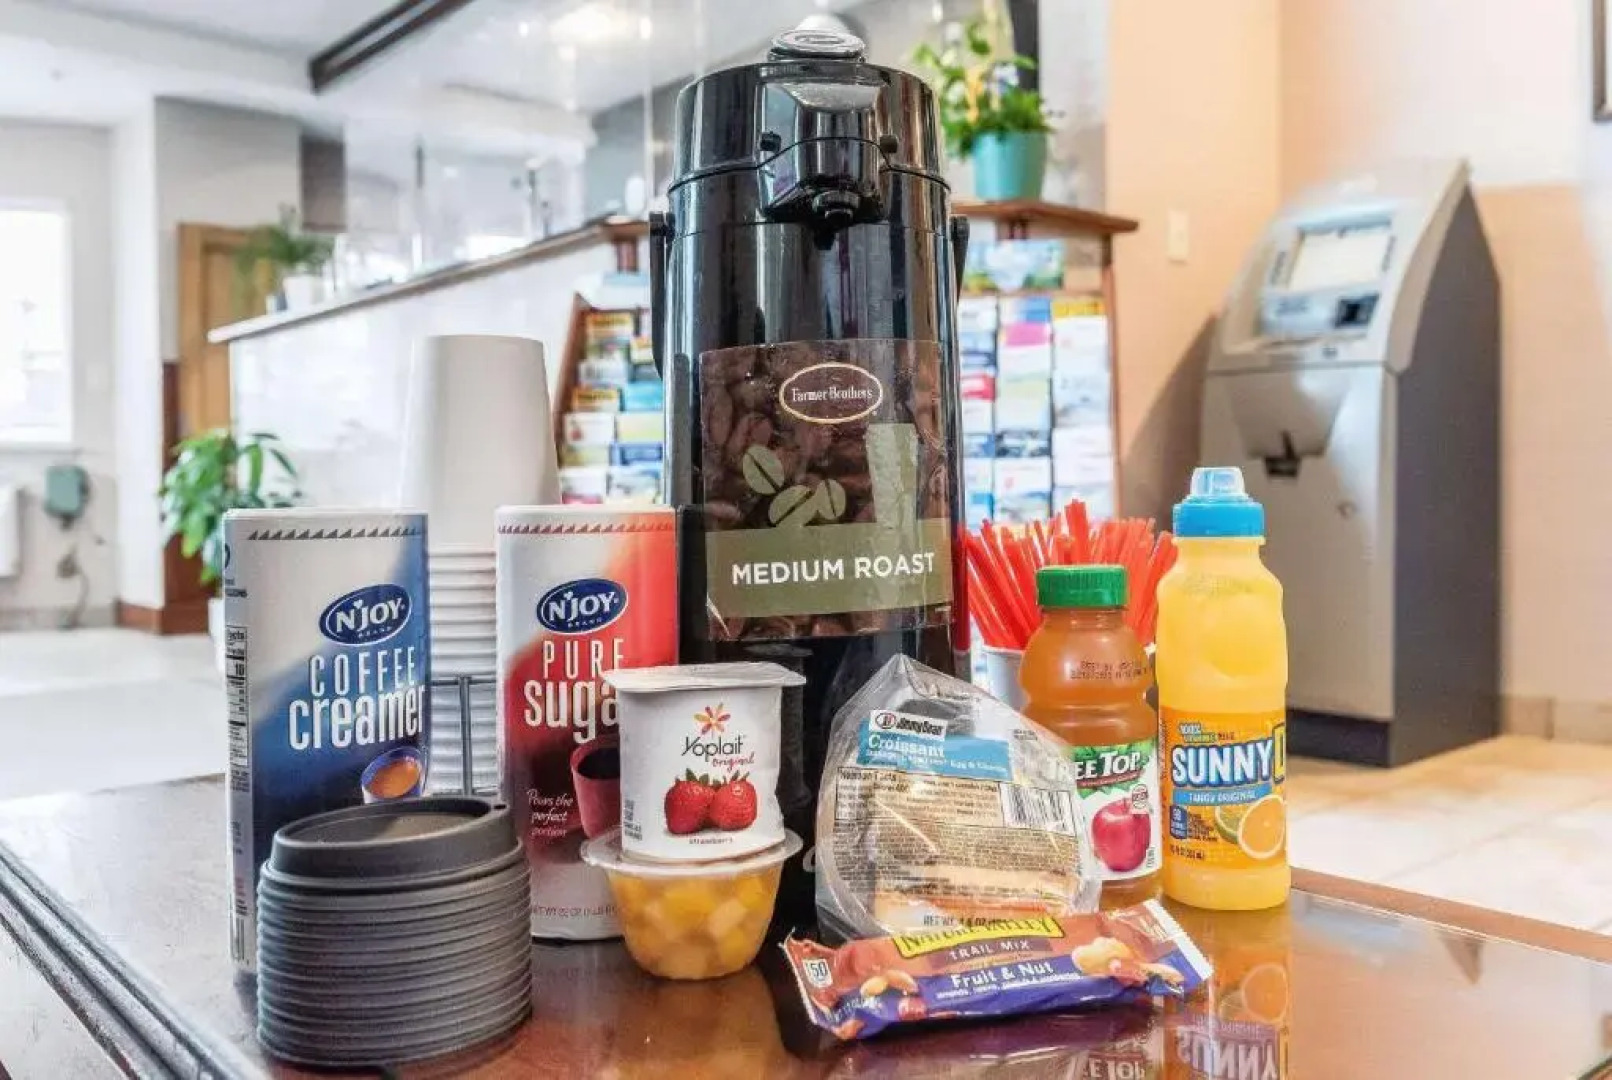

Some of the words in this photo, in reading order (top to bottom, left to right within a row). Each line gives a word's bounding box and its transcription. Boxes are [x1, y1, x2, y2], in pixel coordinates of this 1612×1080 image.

[731, 557, 845, 585] MEDIUM
[854, 552, 935, 580] ROAST
[310, 646, 416, 697] COFFEE
[543, 637, 624, 679] PURE
[288, 684, 426, 750] creamer
[523, 679, 620, 744] suga
[681, 734, 744, 762] Yoplait
[1099, 750, 1141, 777] TOP
[531, 807, 567, 825] perfect
[950, 969, 998, 988] Fruit
[1000, 967, 1015, 980] &
[1018, 961, 1054, 976] Nut
